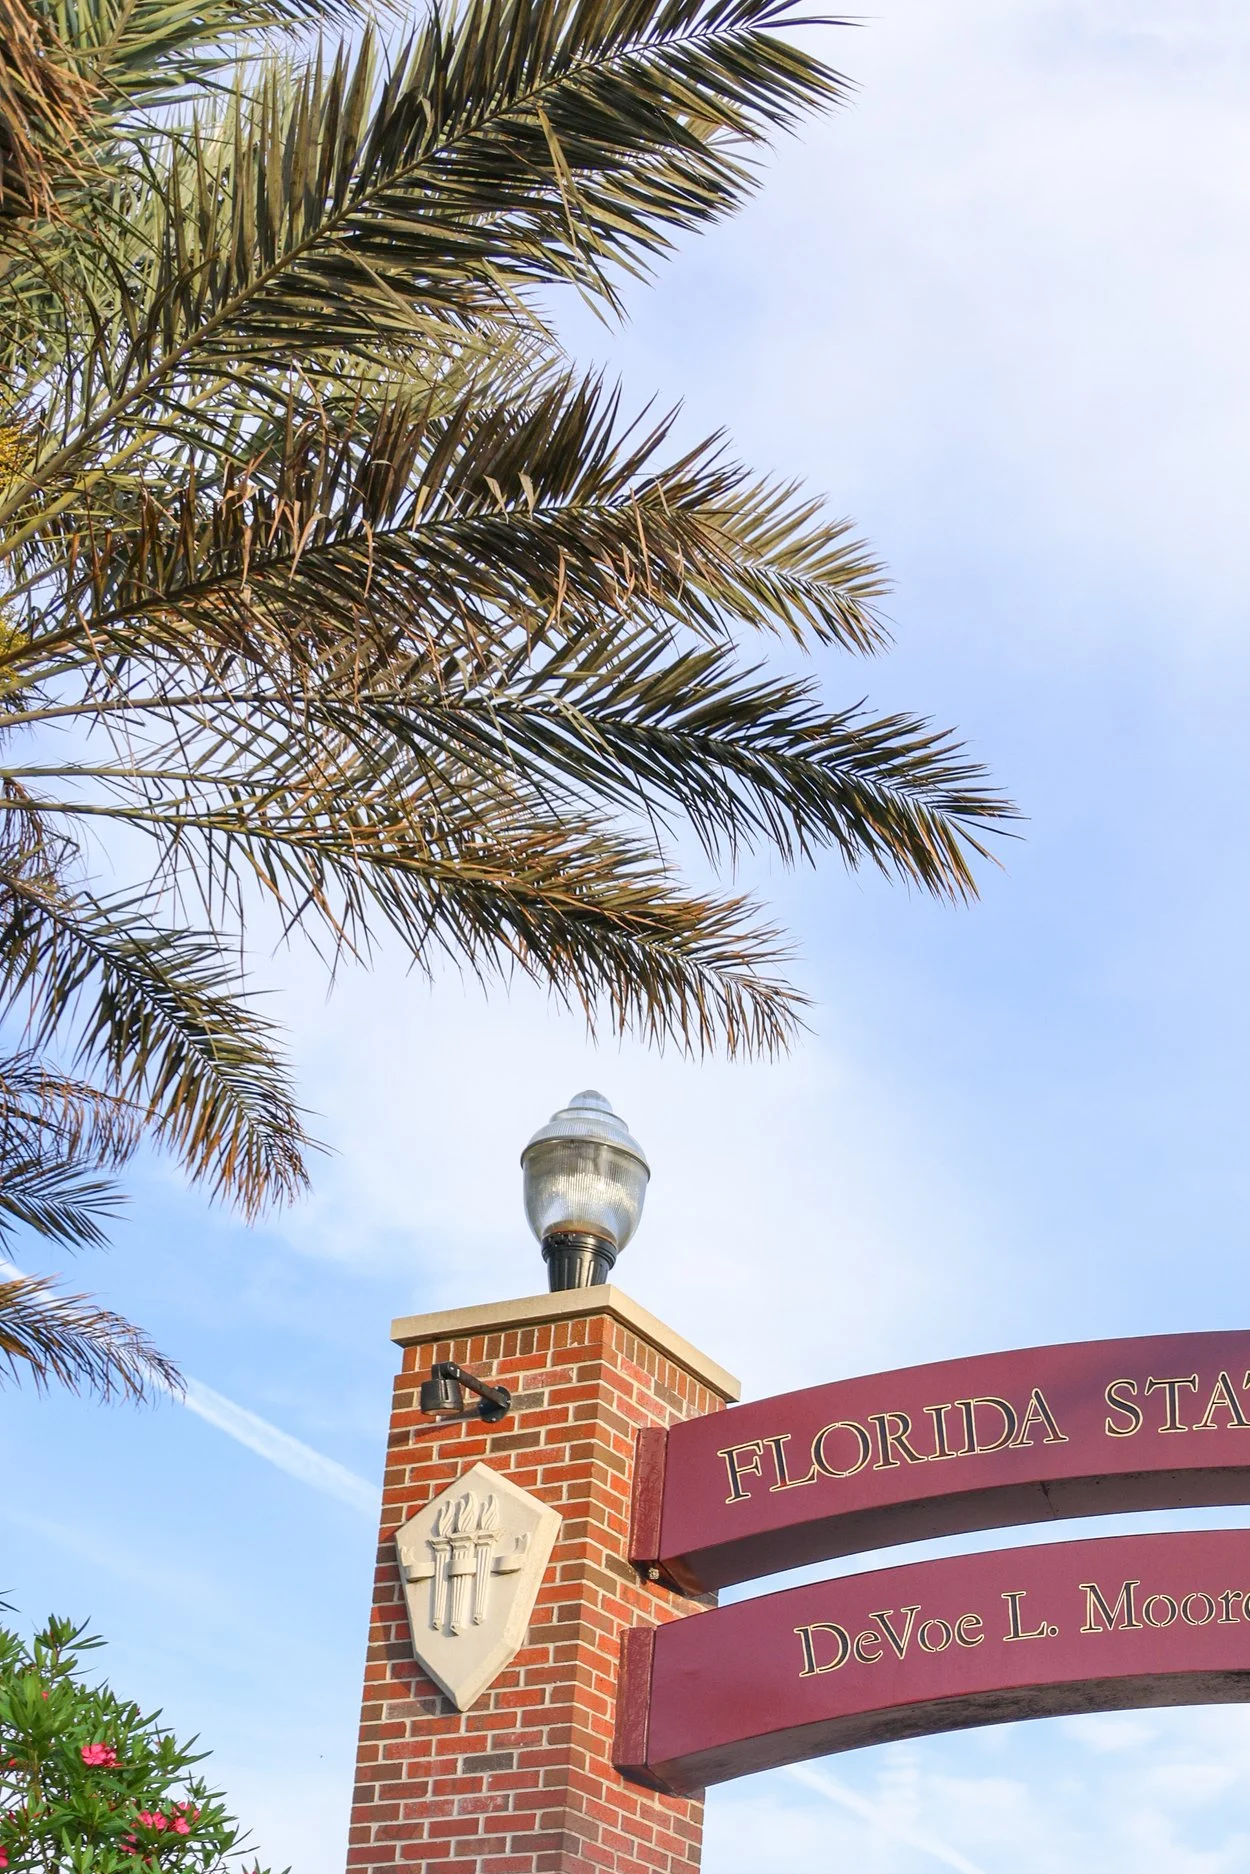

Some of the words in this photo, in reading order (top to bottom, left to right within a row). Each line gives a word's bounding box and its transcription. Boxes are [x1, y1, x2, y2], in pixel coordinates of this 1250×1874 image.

[717, 1389, 1069, 1503] FLORIDA
[794, 1605, 984, 1677] DeVoe
[1002, 1591, 1058, 1641] L.
